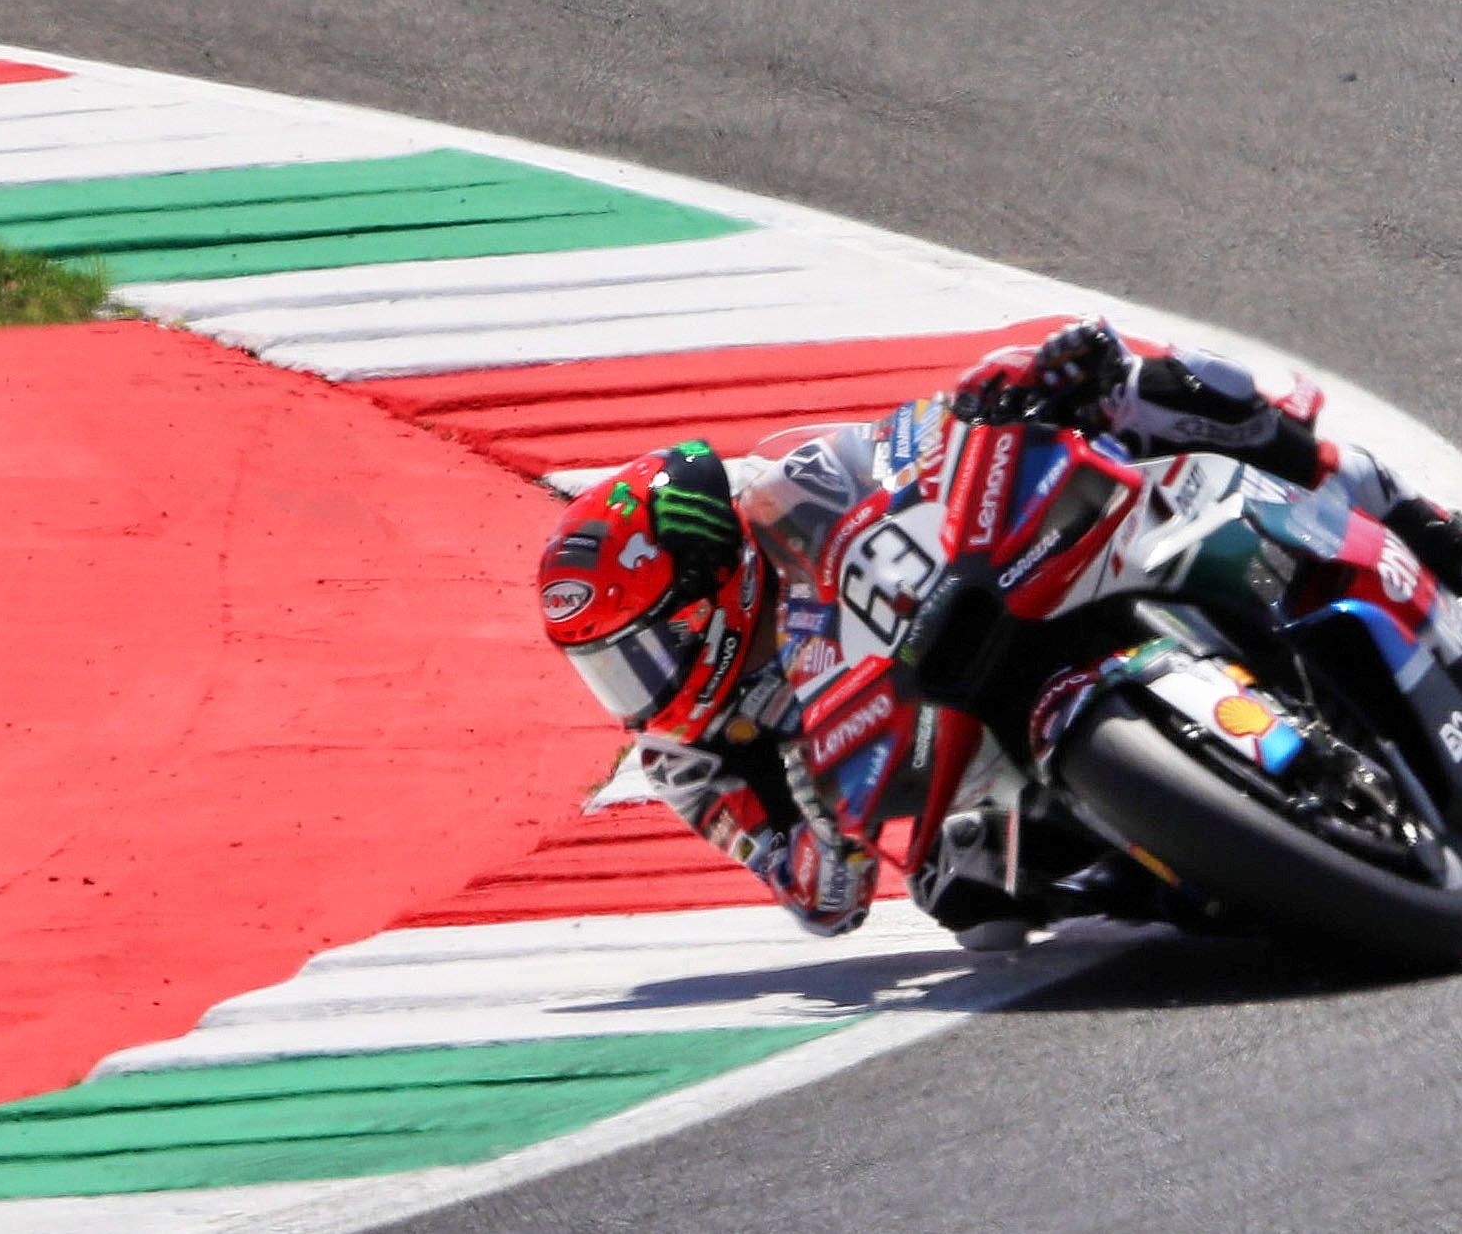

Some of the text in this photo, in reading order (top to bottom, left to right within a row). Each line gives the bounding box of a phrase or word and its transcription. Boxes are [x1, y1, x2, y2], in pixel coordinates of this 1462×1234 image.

[969, 432, 1013, 546] Lenovo
[842, 521, 936, 646] 63
[698, 635, 737, 703] Lenovo
[813, 694, 893, 765] Lenovo
